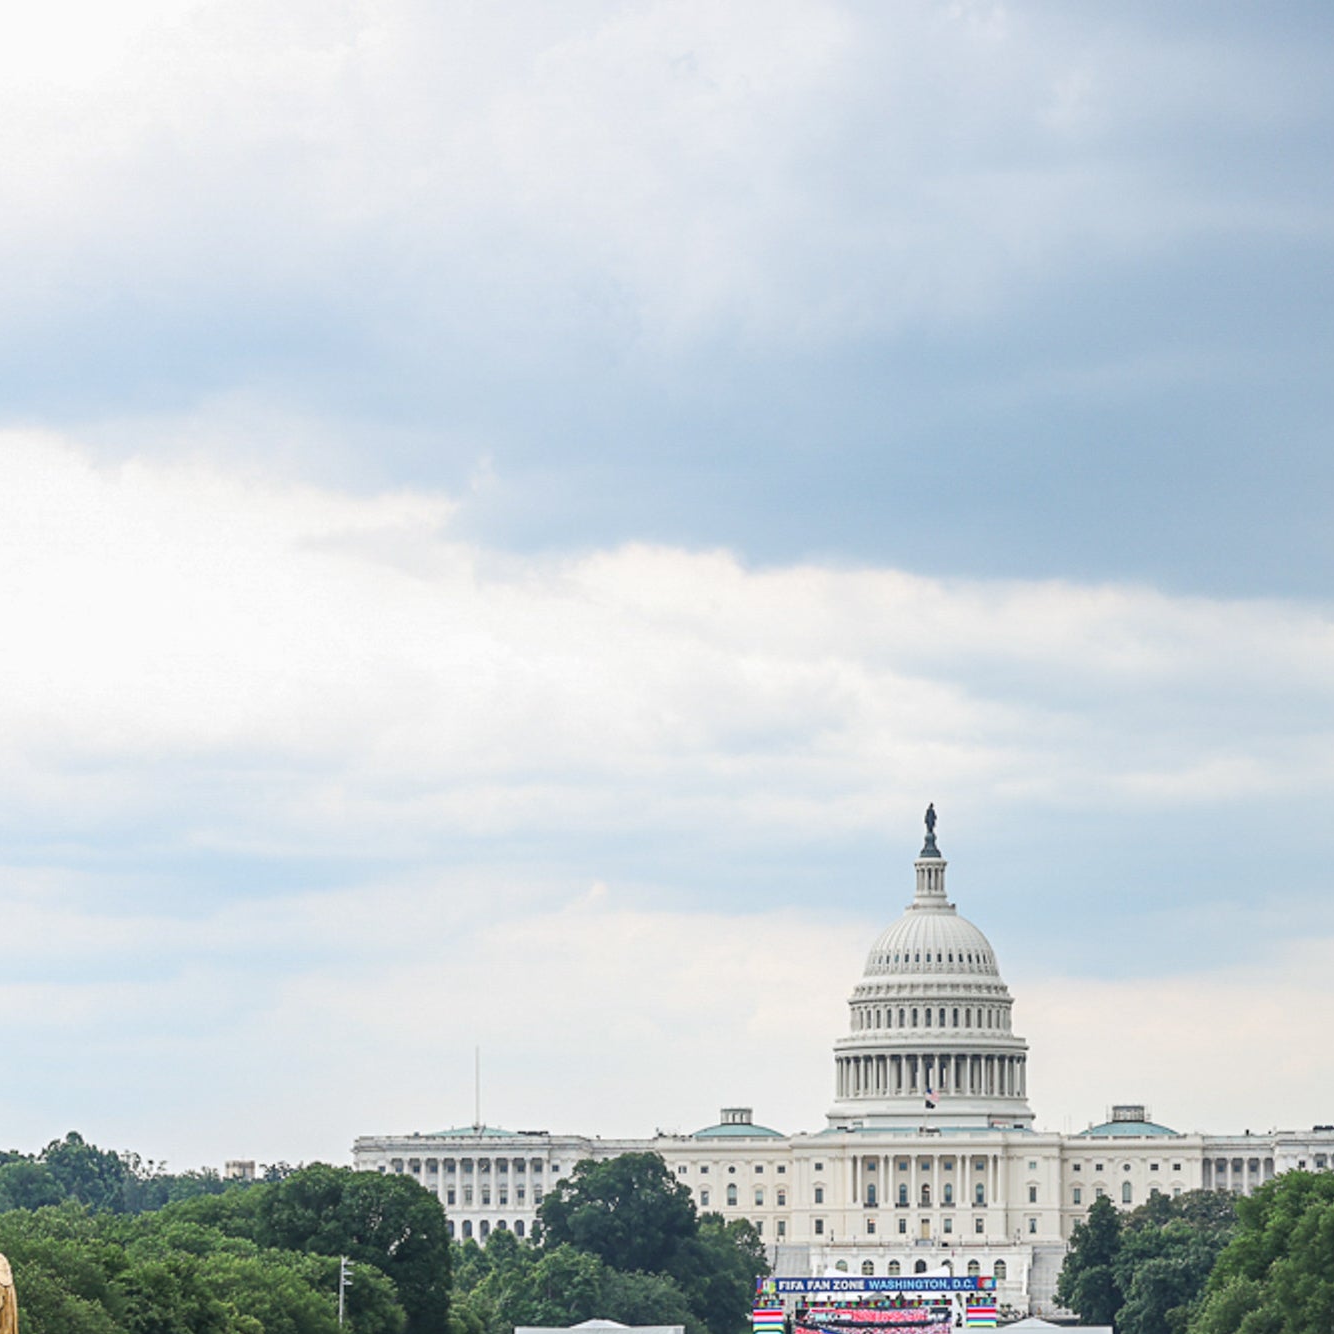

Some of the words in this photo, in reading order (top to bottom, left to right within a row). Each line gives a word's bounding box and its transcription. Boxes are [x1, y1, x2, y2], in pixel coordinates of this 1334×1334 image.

[778, 1280, 804, 1291] FIFA
[807, 1280, 831, 1291] FAN
[833, 1280, 865, 1291] ZONE
[868, 1280, 951, 1291] WASHINGTON,
[952, 1279, 975, 1290] D.C.
